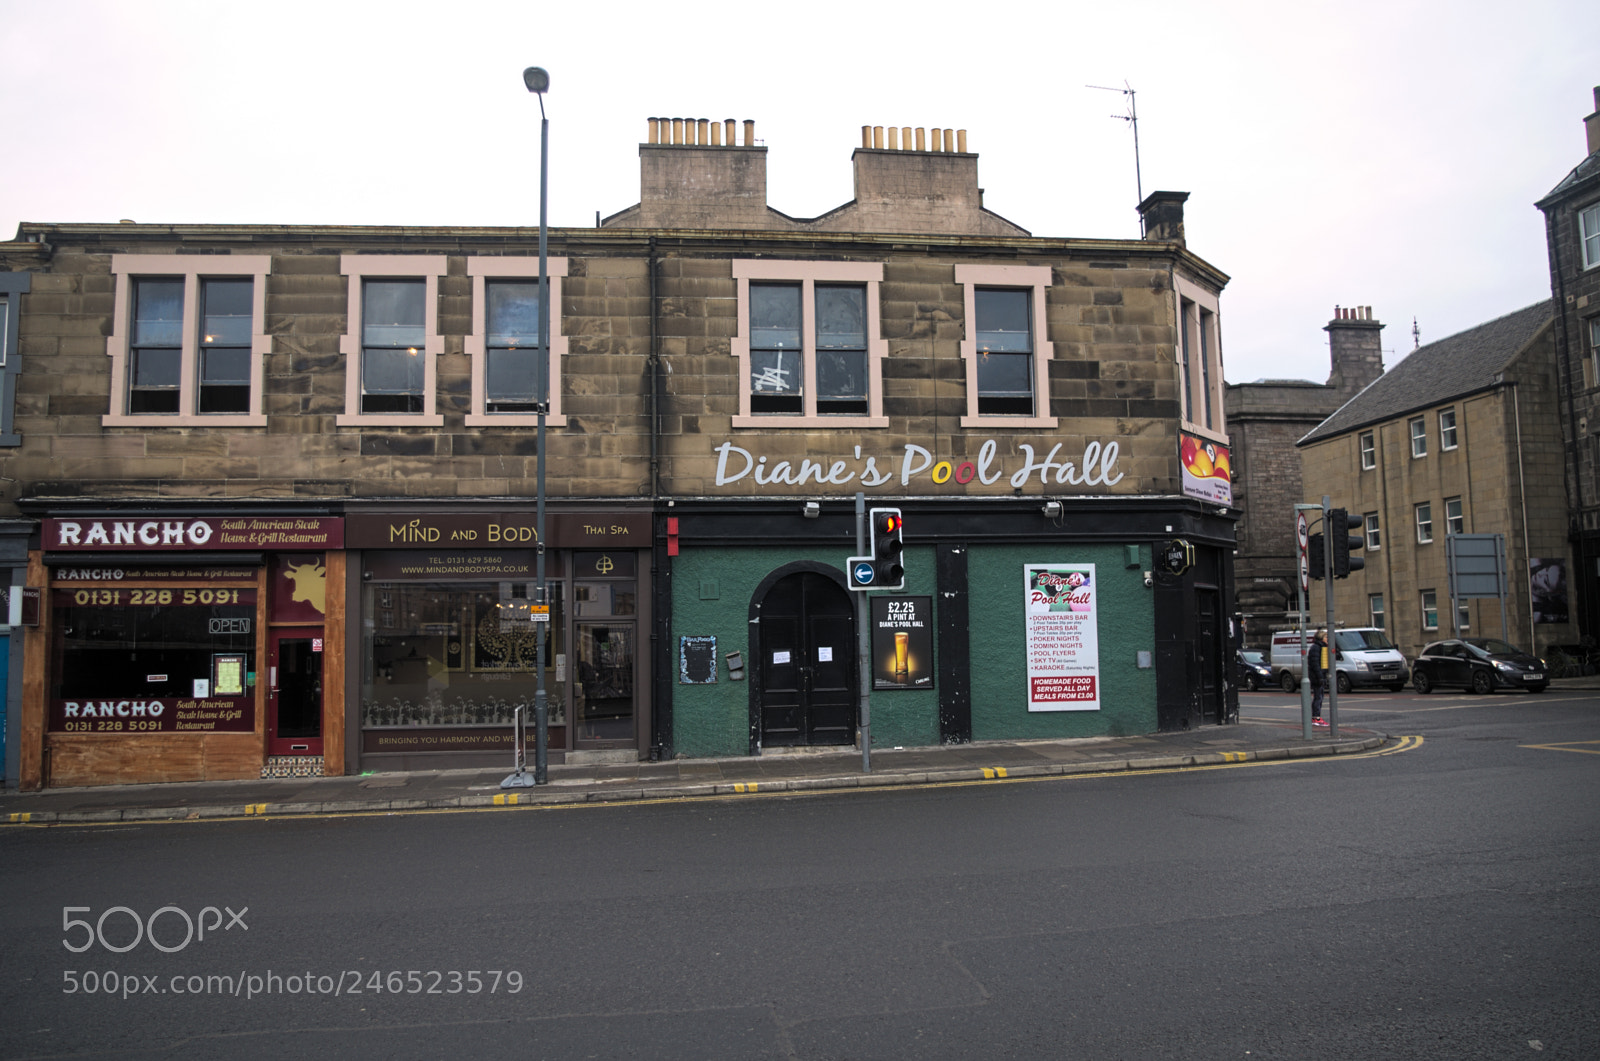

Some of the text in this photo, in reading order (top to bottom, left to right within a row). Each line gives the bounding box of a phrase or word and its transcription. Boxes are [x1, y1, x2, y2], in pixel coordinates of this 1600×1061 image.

[714, 439, 1124, 488] Diane's Pool Hall
[220, 519, 320, 530] South American Steak
[583, 525, 629, 535] THAI SPA
[58, 521, 213, 546] RANCHO
[220, 532, 248, 543] House
[278, 533, 328, 543] Restaurant
[450, 529, 478, 541] AND
[57, 569, 124, 580] RANCHO
[401, 565, 529, 574] WWW.MINDANDBODYSPA.CO.UK
[1038, 573, 1081, 586] Diane's
[74, 589, 239, 605] 0131 228 5091
[1031, 591, 1091, 605] Pool Hall
[888, 601, 915, 613] £2.25
[887, 613, 915, 621] A PINT AT
[211, 620, 249, 632] OPEN
[64, 701, 165, 718] RANCHO
[176, 700, 234, 708] South American
[198, 710, 219, 719] House
[65, 720, 162, 731] 0131 228 5091
[176, 721, 215, 730] Restaurant
[379, 737, 418, 745] BRINGING
